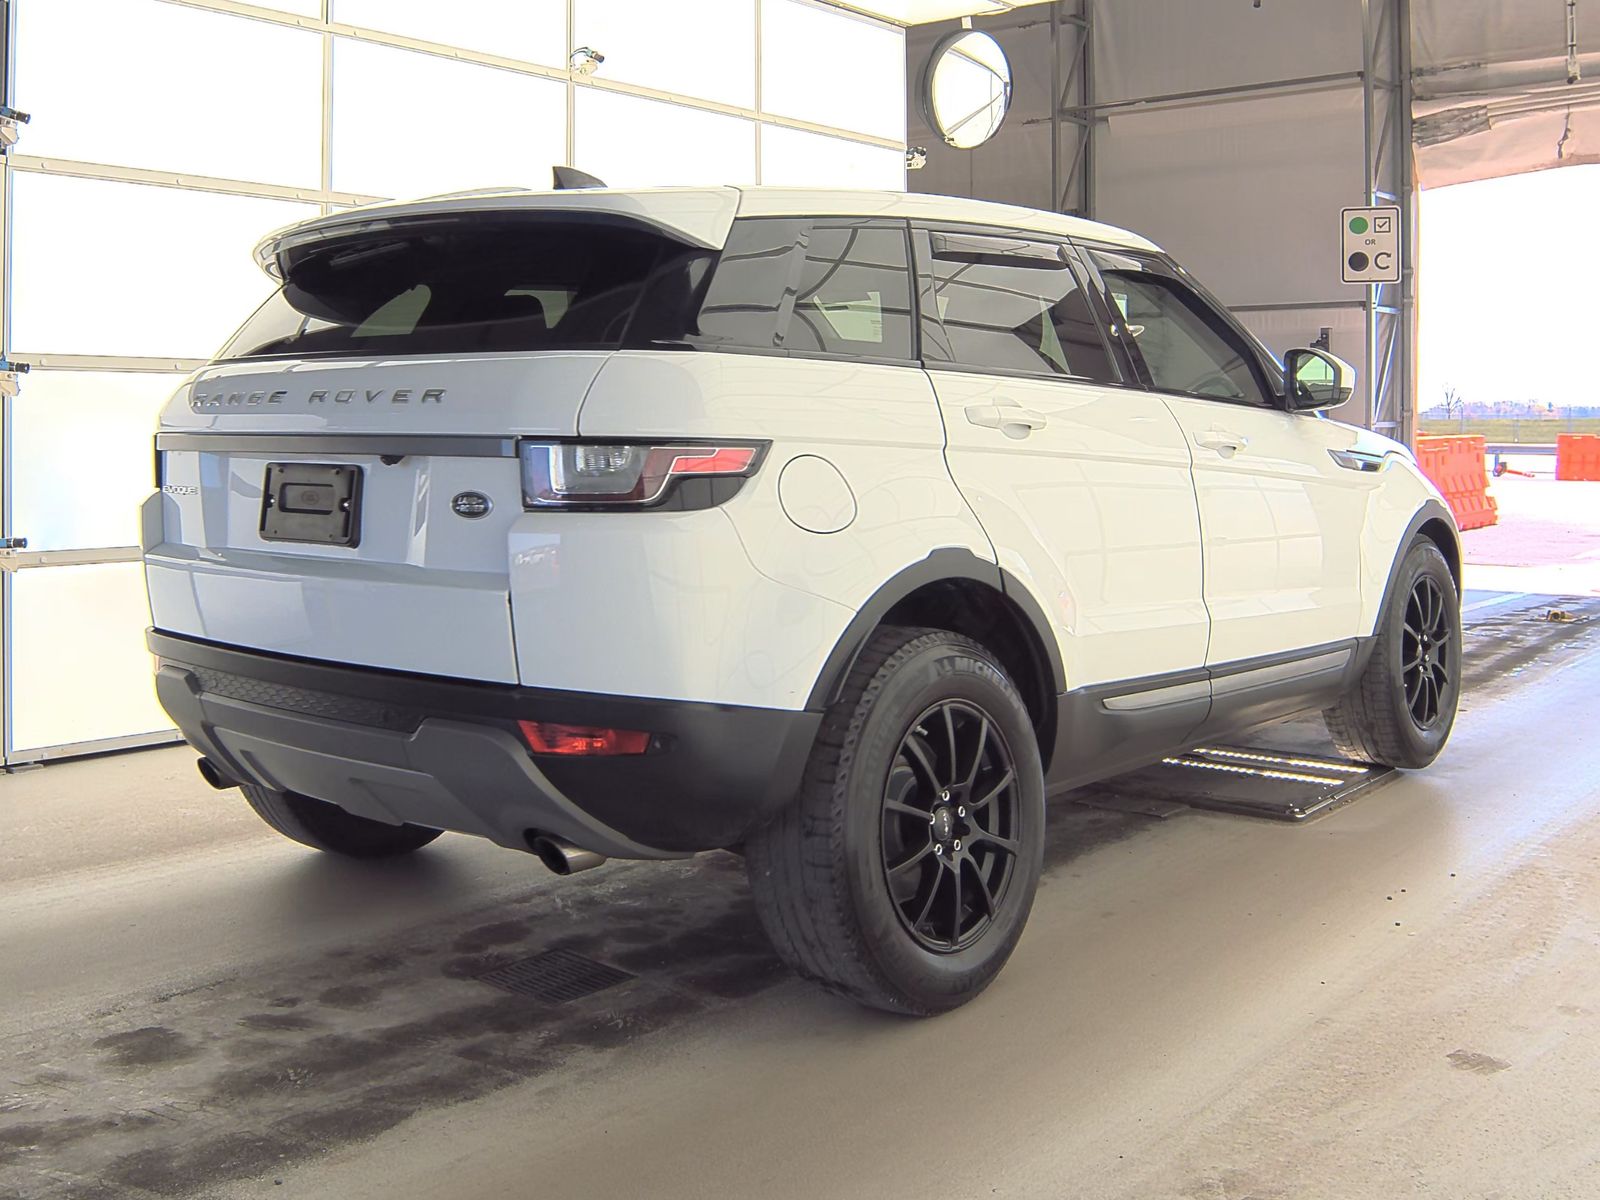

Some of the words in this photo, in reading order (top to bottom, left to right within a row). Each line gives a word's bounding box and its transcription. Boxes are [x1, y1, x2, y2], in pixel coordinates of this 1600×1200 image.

[1364, 238, 1376, 246] OR
[190, 389, 288, 407] RANGE
[308, 388, 447, 404] ROVER
